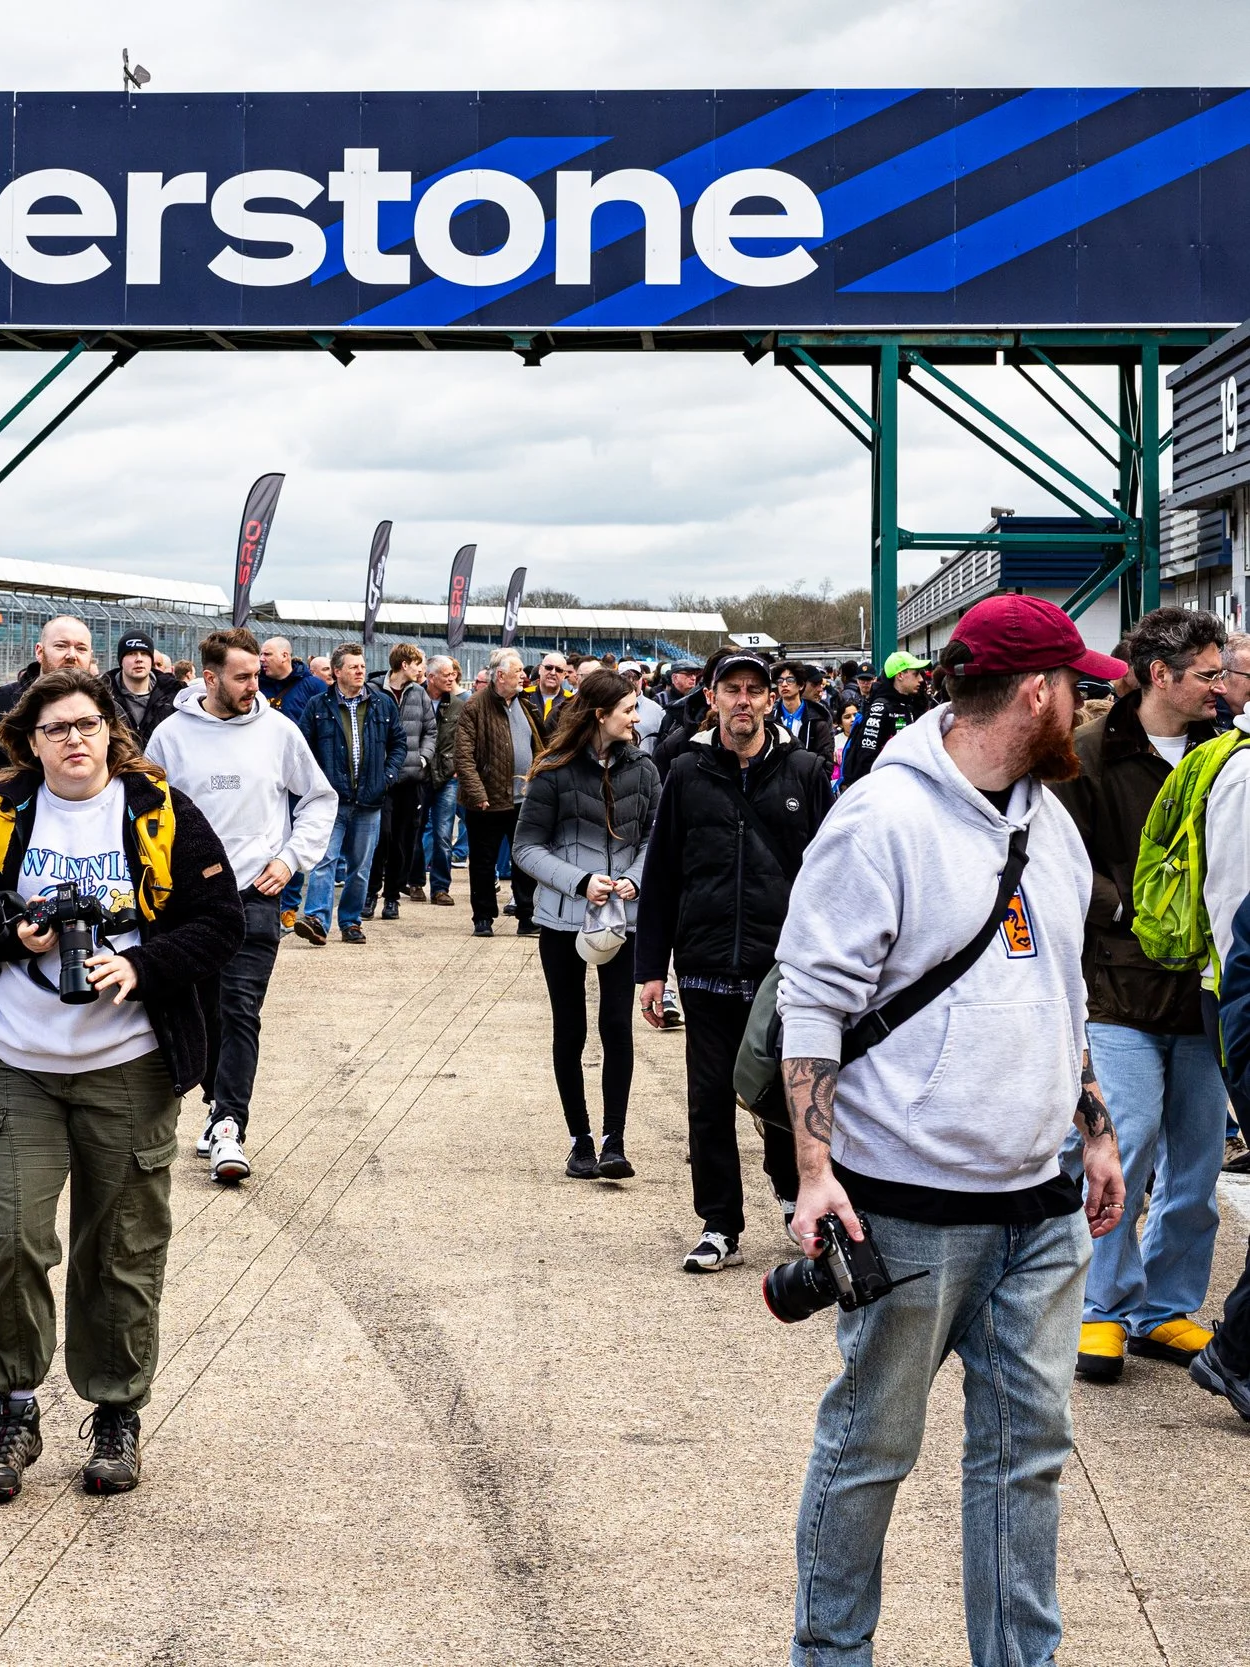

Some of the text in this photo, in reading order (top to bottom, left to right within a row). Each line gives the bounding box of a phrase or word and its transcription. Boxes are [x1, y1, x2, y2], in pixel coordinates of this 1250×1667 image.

[1221, 376, 1238, 455] 19
[239, 520, 261, 584] SRO
[452, 576, 464, 618] SRO
[748, 636, 760, 644] 13
